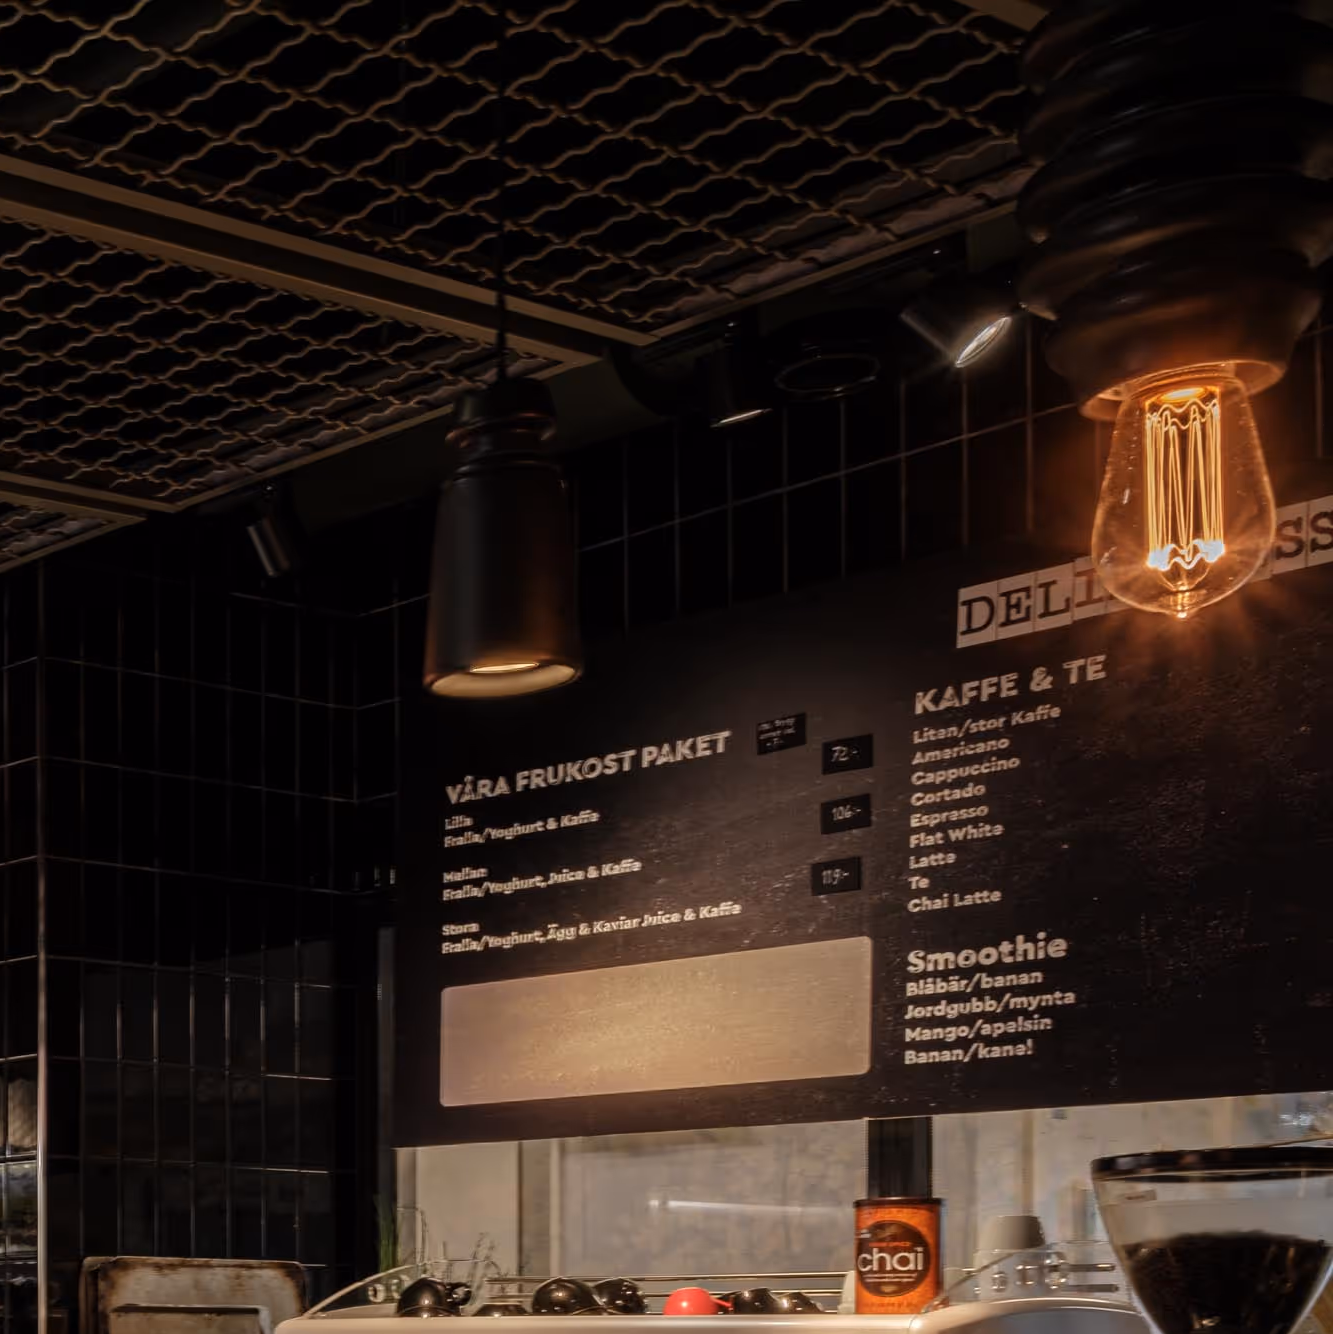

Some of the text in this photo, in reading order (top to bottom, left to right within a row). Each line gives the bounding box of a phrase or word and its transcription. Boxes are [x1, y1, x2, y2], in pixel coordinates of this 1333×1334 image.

[914, 654, 1107, 715] KAFFE & TE
[1011, 704, 1062, 726] Kaffe
[912, 738, 1010, 765] Americano
[445, 775, 511, 805] VÅRA
[516, 749, 637, 792] FRUKOST
[641, 730, 732, 768] PAKET
[911, 757, 1020, 785] Cappuccino
[910, 783, 986, 806] Cortado
[560, 810, 600, 828] Kaffe
[910, 805, 989, 829] Espresso
[910, 823, 1005, 848] Flat White
[601, 859, 643, 876] Kaffe
[909, 853, 956, 869] Latte
[908, 876, 930, 889] Te
[699, 901, 742, 919] Kaffe
[907, 889, 1002, 912] Chai Latte
[442, 921, 480, 936] Stora
[907, 931, 1068, 973] Smoothie
[906, 971, 1044, 997] Blåbär/banan
[904, 990, 1076, 1020] Jordgubb/mynta
[904, 1014, 1053, 1043] Mango/apelsin
[904, 1038, 1034, 1065] Banan/kanel
[858, 1247, 924, 1272] chai
